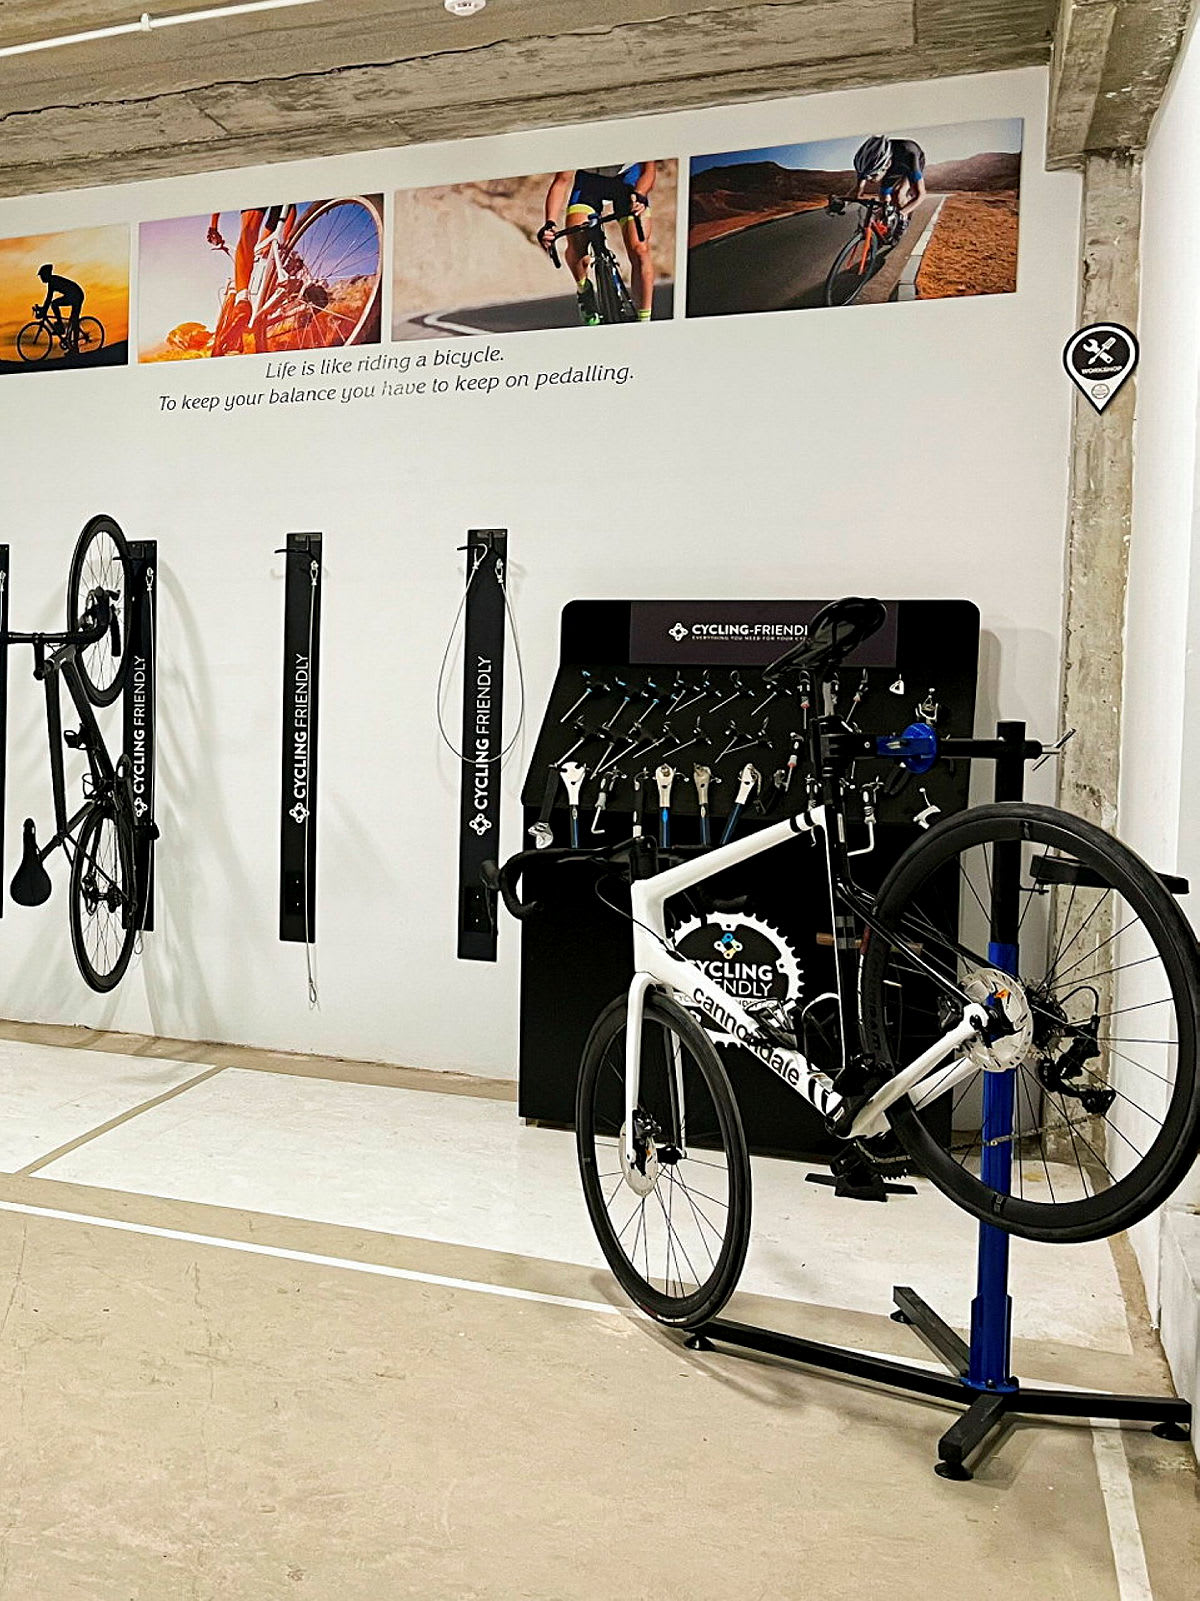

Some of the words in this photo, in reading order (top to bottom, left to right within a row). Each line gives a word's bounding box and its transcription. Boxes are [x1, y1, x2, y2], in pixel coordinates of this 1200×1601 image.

[159, 395, 177, 411] To
[182, 394, 220, 412] keep
[224, 391, 264, 411] your
[269, 387, 337, 405] balance
[340, 383, 375, 403] you
[381, 380, 426, 397] have
[432, 378, 449, 393] to
[455, 375, 500, 394] keep
[505, 373, 529, 388] on
[534, 365, 634, 390] pedalling.
[265, 360, 296, 380] Life
[301, 360, 315, 377] is
[319, 358, 352, 375] like
[357, 354, 410, 373] riding
[415, 355, 427, 368] a
[433, 345, 504, 369] bicycle.
[133, 655, 146, 726] FRIENDLY
[294, 653, 309, 728] FRIENDLY
[476, 655, 492, 734] FRIENDLY
[133, 729, 146, 794] CYCLING
[293, 731, 308, 799] CYCLING
[474, 738, 490, 810] CYCLING
[690, 960, 773, 981] YCLING
